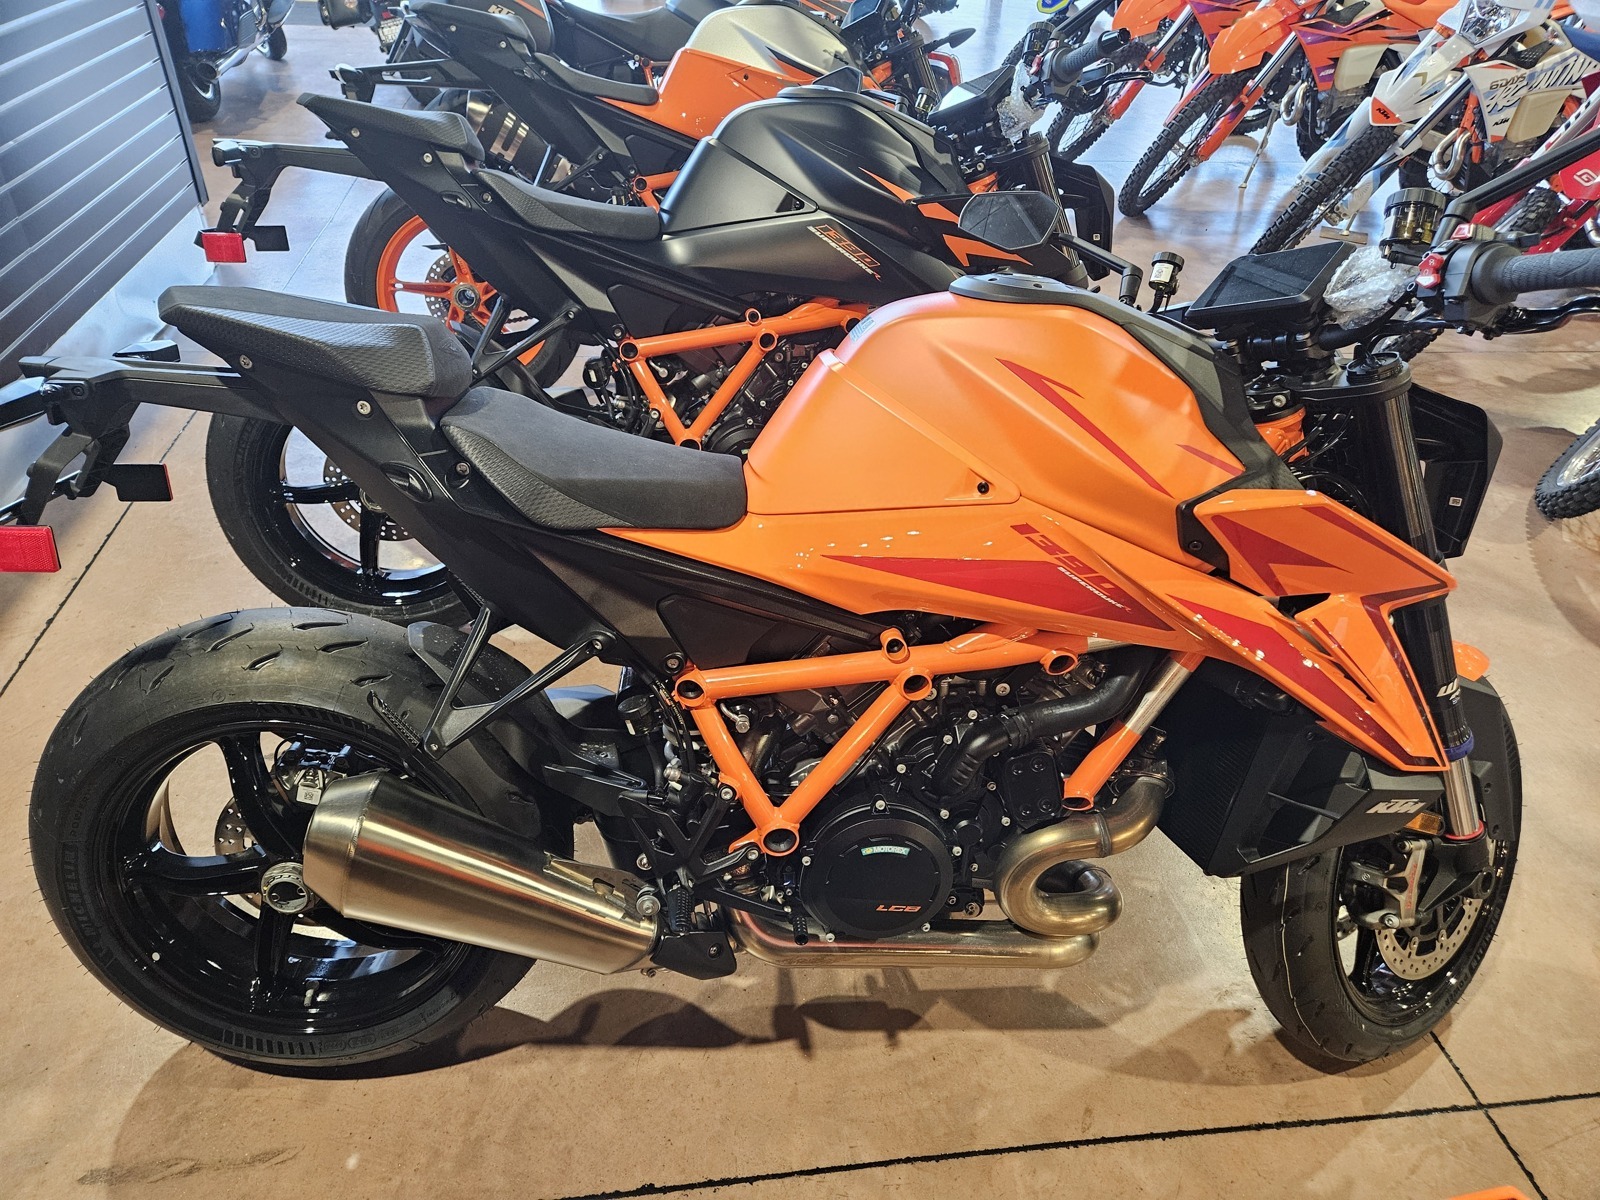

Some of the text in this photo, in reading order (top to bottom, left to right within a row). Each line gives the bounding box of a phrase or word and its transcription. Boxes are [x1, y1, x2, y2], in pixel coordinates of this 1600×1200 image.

[1376, 108, 1391, 119] KTM
[1493, 118, 1510, 126] KTM
[815, 224, 880, 267] 1390
[1010, 522, 1121, 597] 1390
[1365, 799, 1426, 814] KTM
[873, 845, 907, 853] MOTOREX
